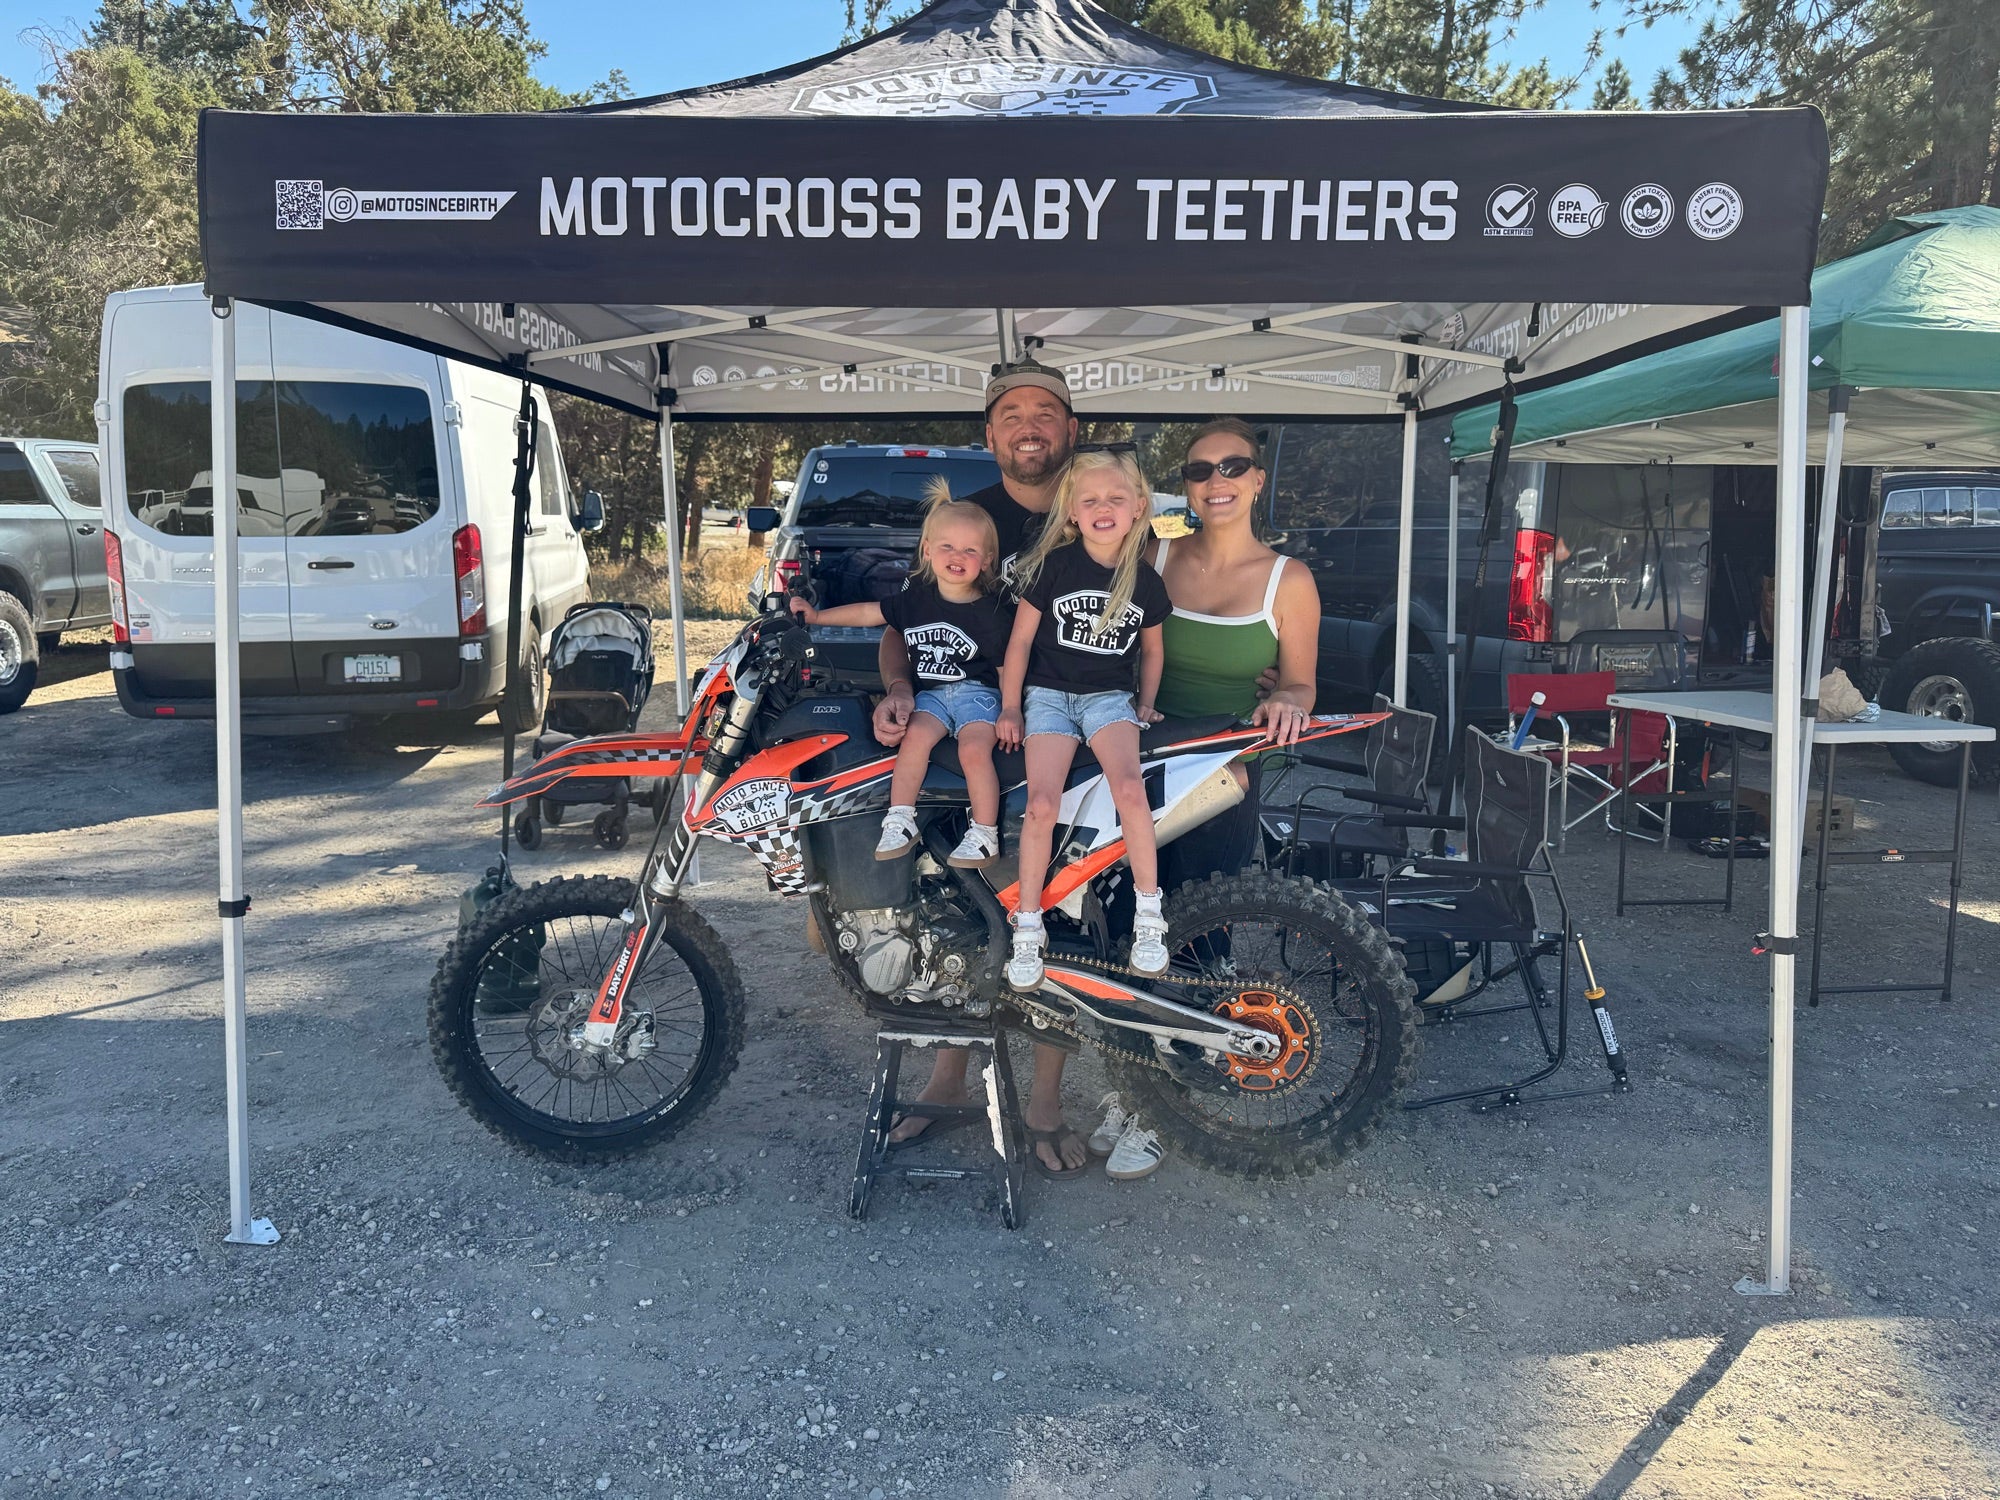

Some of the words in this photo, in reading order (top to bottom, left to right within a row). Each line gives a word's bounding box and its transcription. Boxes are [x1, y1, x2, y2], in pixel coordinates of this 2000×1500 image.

[821, 67, 980, 102] MOTO
[1011, 66, 1190, 91] SINCE
[1631, 188, 1646, 200] NON
[1648, 187, 1666, 200] TOXIC
[1695, 187, 1714, 203] PATENT
[1715, 187, 1736, 204] PENDING
[361, 197, 498, 213] @MOTOSINCEBIRTH
[539, 177, 921, 238] MOTOCROSS
[946, 178, 1116, 239] BABY
[1136, 179, 1458, 240] TEETHERS
[1557, 200, 1582, 212] BPA
[1556, 212, 1588, 224] FREE
[1693, 218, 1711, 234] PATENT
[1711, 219, 1735, 235] PENDING
[1484, 228, 1501, 236] ASTM
[1502, 228, 1533, 236] CERTIFIED
[1629, 223, 1643, 234] NON
[1644, 223, 1663, 234] TOXIC
[1059, 597, 1098, 615] MOTO
[1104, 599, 1140, 626] SCE
[906, 629, 940, 646] MOTO
[941, 629, 971, 656] SINCE
[1072, 629, 1118, 649] BIRTH
[355, 661, 391, 675] CH151
[916, 661, 956, 675] BIRTH
[812, 705, 841, 714] IMS
[716, 788, 747, 813] MOTO
[750, 781, 785, 794] SINCE
[740, 808, 779, 829] BIRTH
[608, 972, 622, 997] DAY
[617, 948, 632, 979] DIRT
[626, 931, 637, 948] GP
[1598, 1012, 1612, 1041] ROCKER
